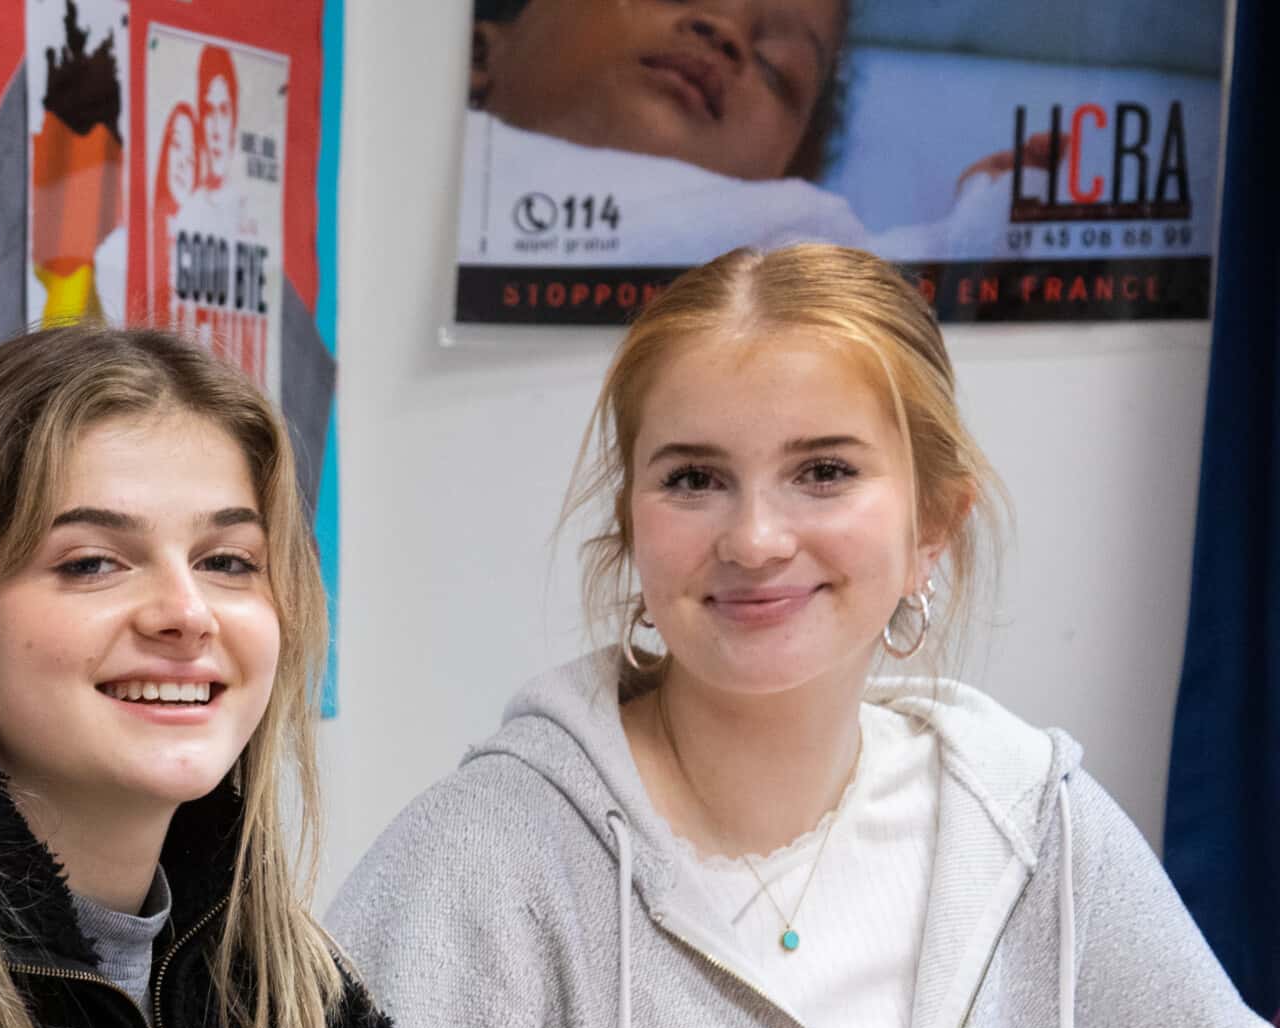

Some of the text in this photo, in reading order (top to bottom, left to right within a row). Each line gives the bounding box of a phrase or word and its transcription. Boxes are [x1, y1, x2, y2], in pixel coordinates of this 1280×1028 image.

[1010, 101, 1190, 205] LICRA
[562, 194, 620, 229] 114
[177, 230, 268, 313] GOOD BYE
[959, 277, 999, 304] EN
